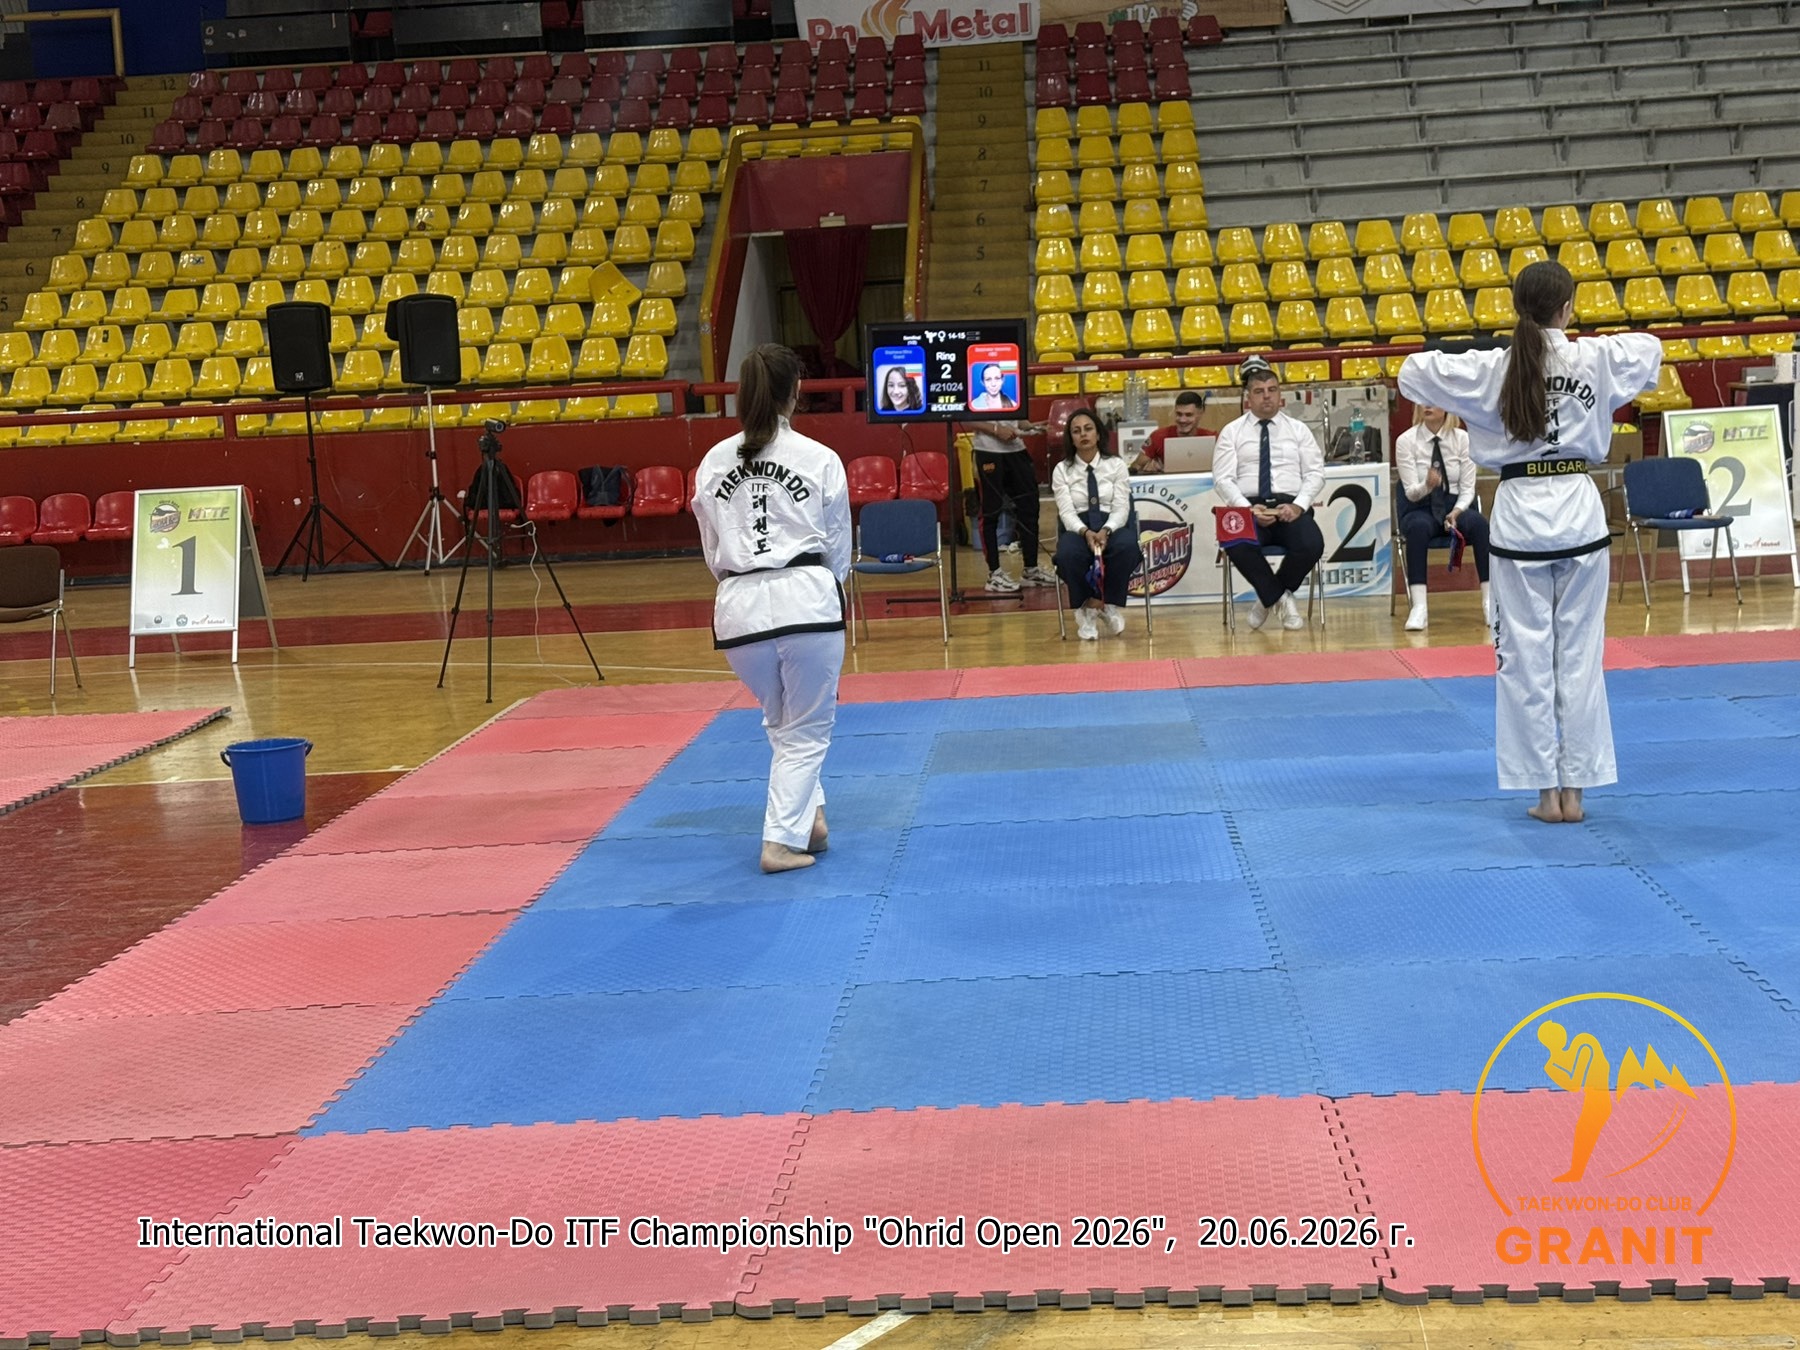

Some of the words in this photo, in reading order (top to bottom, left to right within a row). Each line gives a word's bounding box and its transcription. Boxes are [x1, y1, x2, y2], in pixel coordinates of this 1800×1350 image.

[912, 2, 1031, 41] Metal
[162, 79, 176, 91] 12
[979, 85, 993, 98] 10
[142, 107, 155, 118] 11
[977, 114, 986, 126] 9
[120, 133, 135, 145] 10
[977, 147, 987, 160] 8
[101, 162, 110, 174] 9
[979, 179, 989, 191] 7
[76, 196, 85, 209] 8
[976, 212, 986, 224] 6
[51, 228, 61, 241] 7
[976, 246, 985, 260] 5
[25, 262, 34, 276] 6
[972, 282, 983, 295] 4
[0, 297, 9, 312] 5
[935, 351, 956, 362] Ring
[940, 363, 952, 379] 2
[929, 382, 964, 392] #21024
[714, 460, 810, 502] TAEKWON-DO
[751, 482, 770, 493] ITF
[1708, 456, 1752, 517] 2
[1159, 487, 1189, 512] Open
[752, 494, 772, 556] 태권도
[1326, 484, 1377, 563] 2
[171, 535, 203, 596] 1
